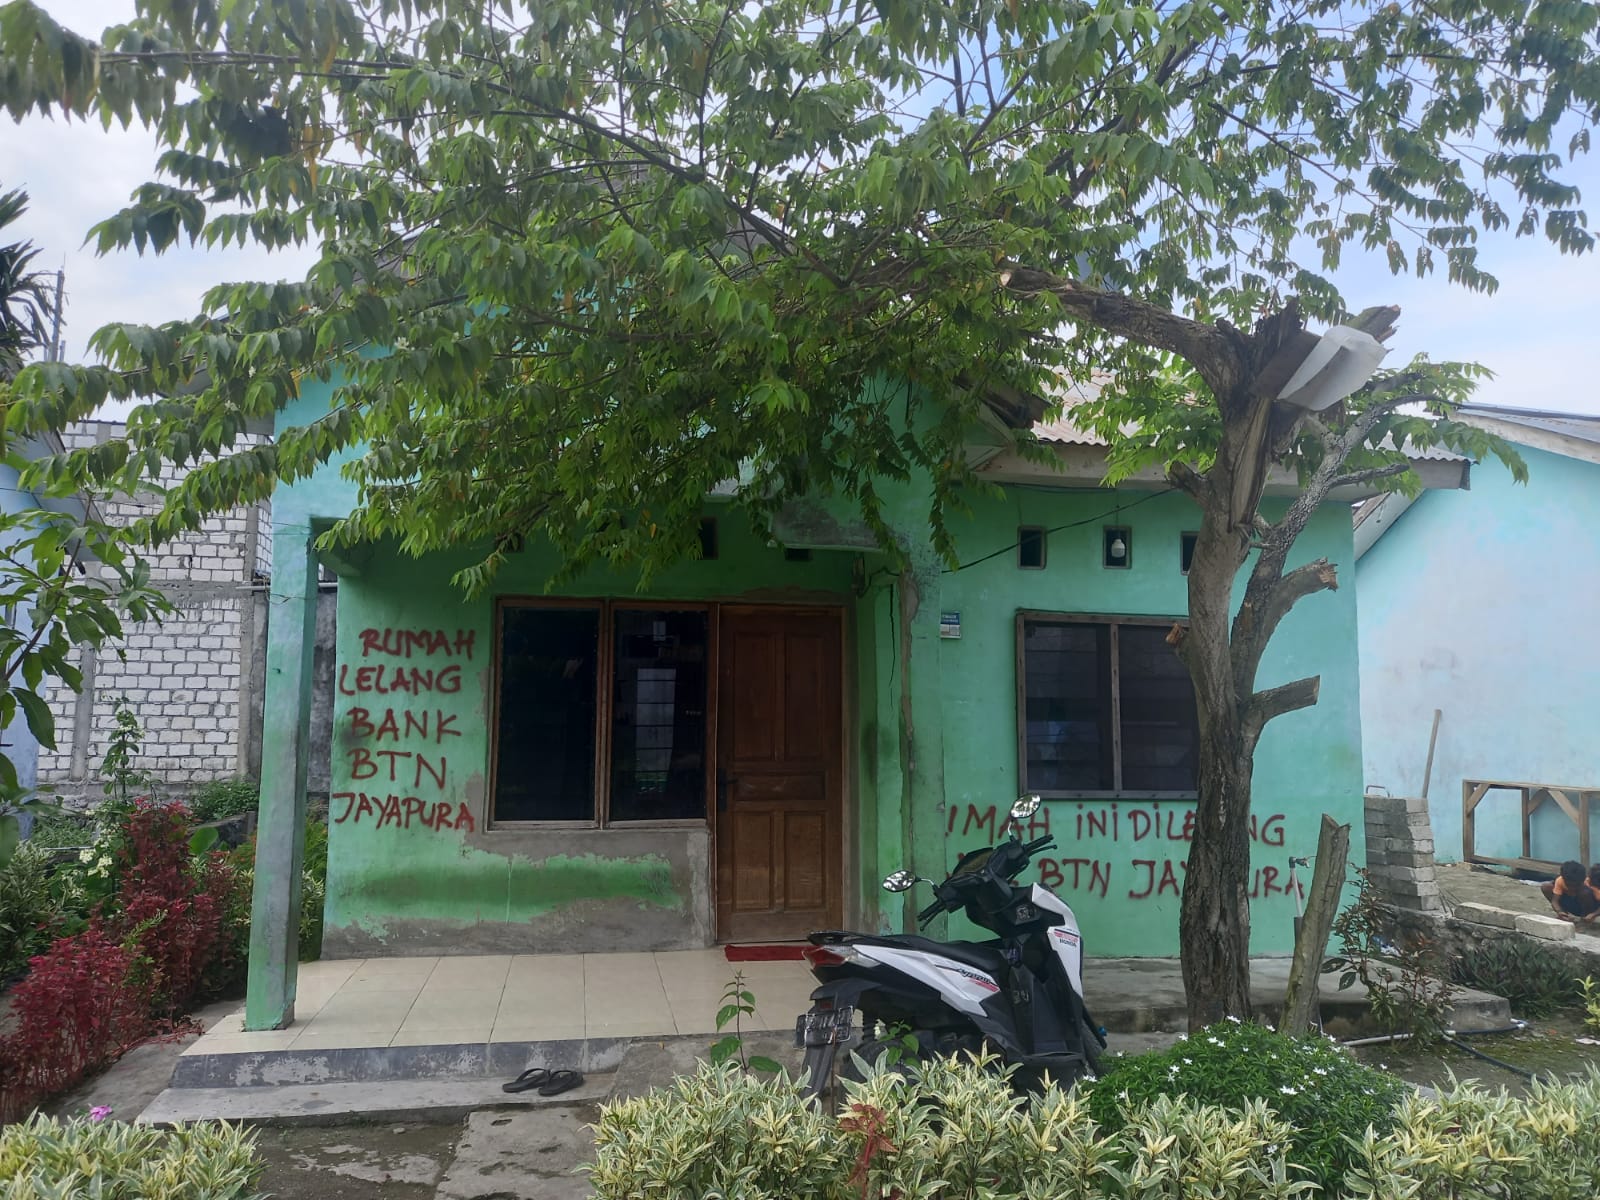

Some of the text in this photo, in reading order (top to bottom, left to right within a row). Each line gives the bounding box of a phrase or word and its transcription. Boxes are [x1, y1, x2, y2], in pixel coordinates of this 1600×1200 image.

[359, 628, 476, 660] RUMAH
[339, 664, 462, 696] LELANG
[347, 707, 462, 744] BANK
[347, 748, 446, 790] BTN
[332, 792, 475, 833] JAYAPURA
[1038, 858, 1111, 898] BTN
